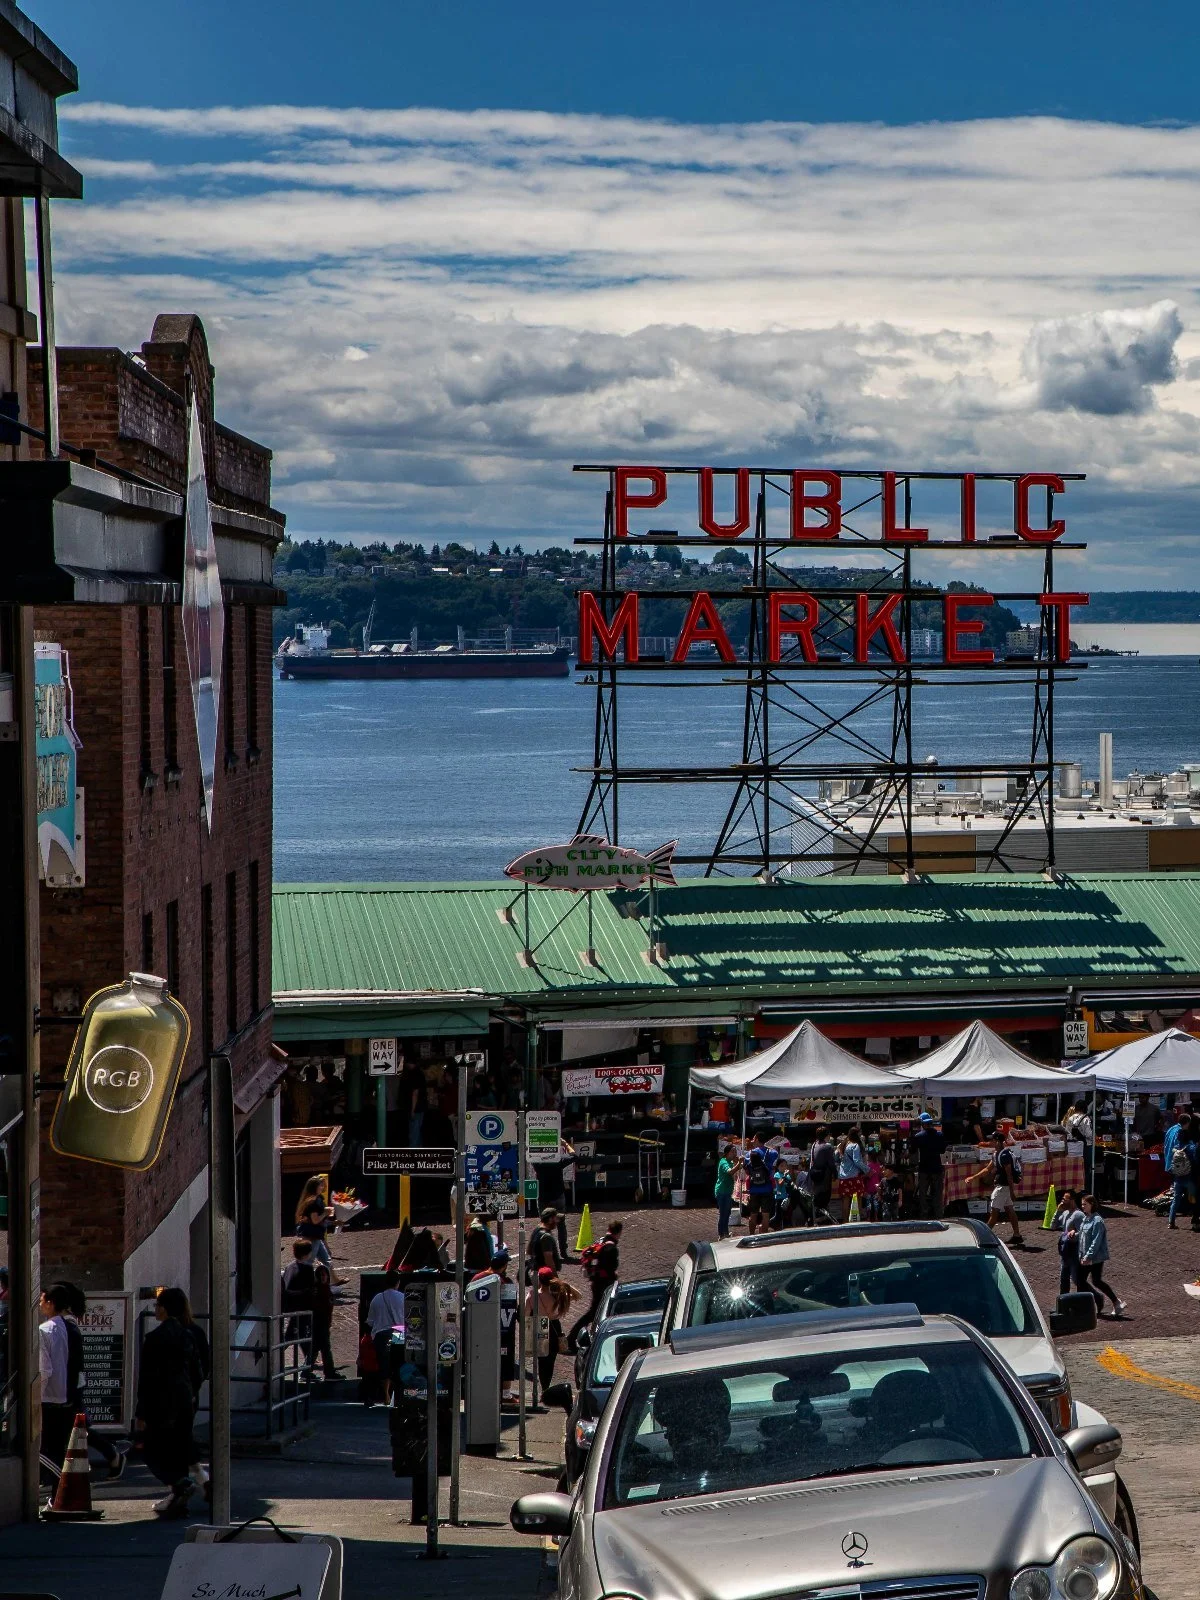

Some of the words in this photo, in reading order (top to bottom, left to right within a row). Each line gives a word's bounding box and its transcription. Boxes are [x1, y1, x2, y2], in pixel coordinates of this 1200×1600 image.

[613, 466, 1066, 542] PUBLIC
[577, 590, 1090, 663] MARKET
[566, 849, 617, 861] CITY
[524, 865, 569, 877] FISH
[577, 863, 657, 876] MARKET
[1065, 1023, 1086, 1033] ONE
[1065, 1033, 1086, 1042] WAY
[372, 1040, 394, 1051] ONE
[372, 1051, 394, 1061] WAY
[93, 1068, 140, 1087] RGB
[597, 1069, 616, 1077] 100%
[618, 1067, 661, 1076] ORGANIC
[821, 1100, 914, 1113] Orchards
[823, 1112, 860, 1121] CSHMERE
[485, 1120, 498, 1135] P
[367, 1161, 388, 1169] Pike
[389, 1161, 415, 1169] Place
[417, 1161, 451, 1169] Market
[482, 1149, 500, 1172] 2
[479, 1289, 488, 1299] P
[87, 1379, 120, 1387] BARBER
[86, 1406, 111, 1414] PUBLIC
[191, 1582, 216, 1599] So
[217, 1582, 266, 1599] Much
